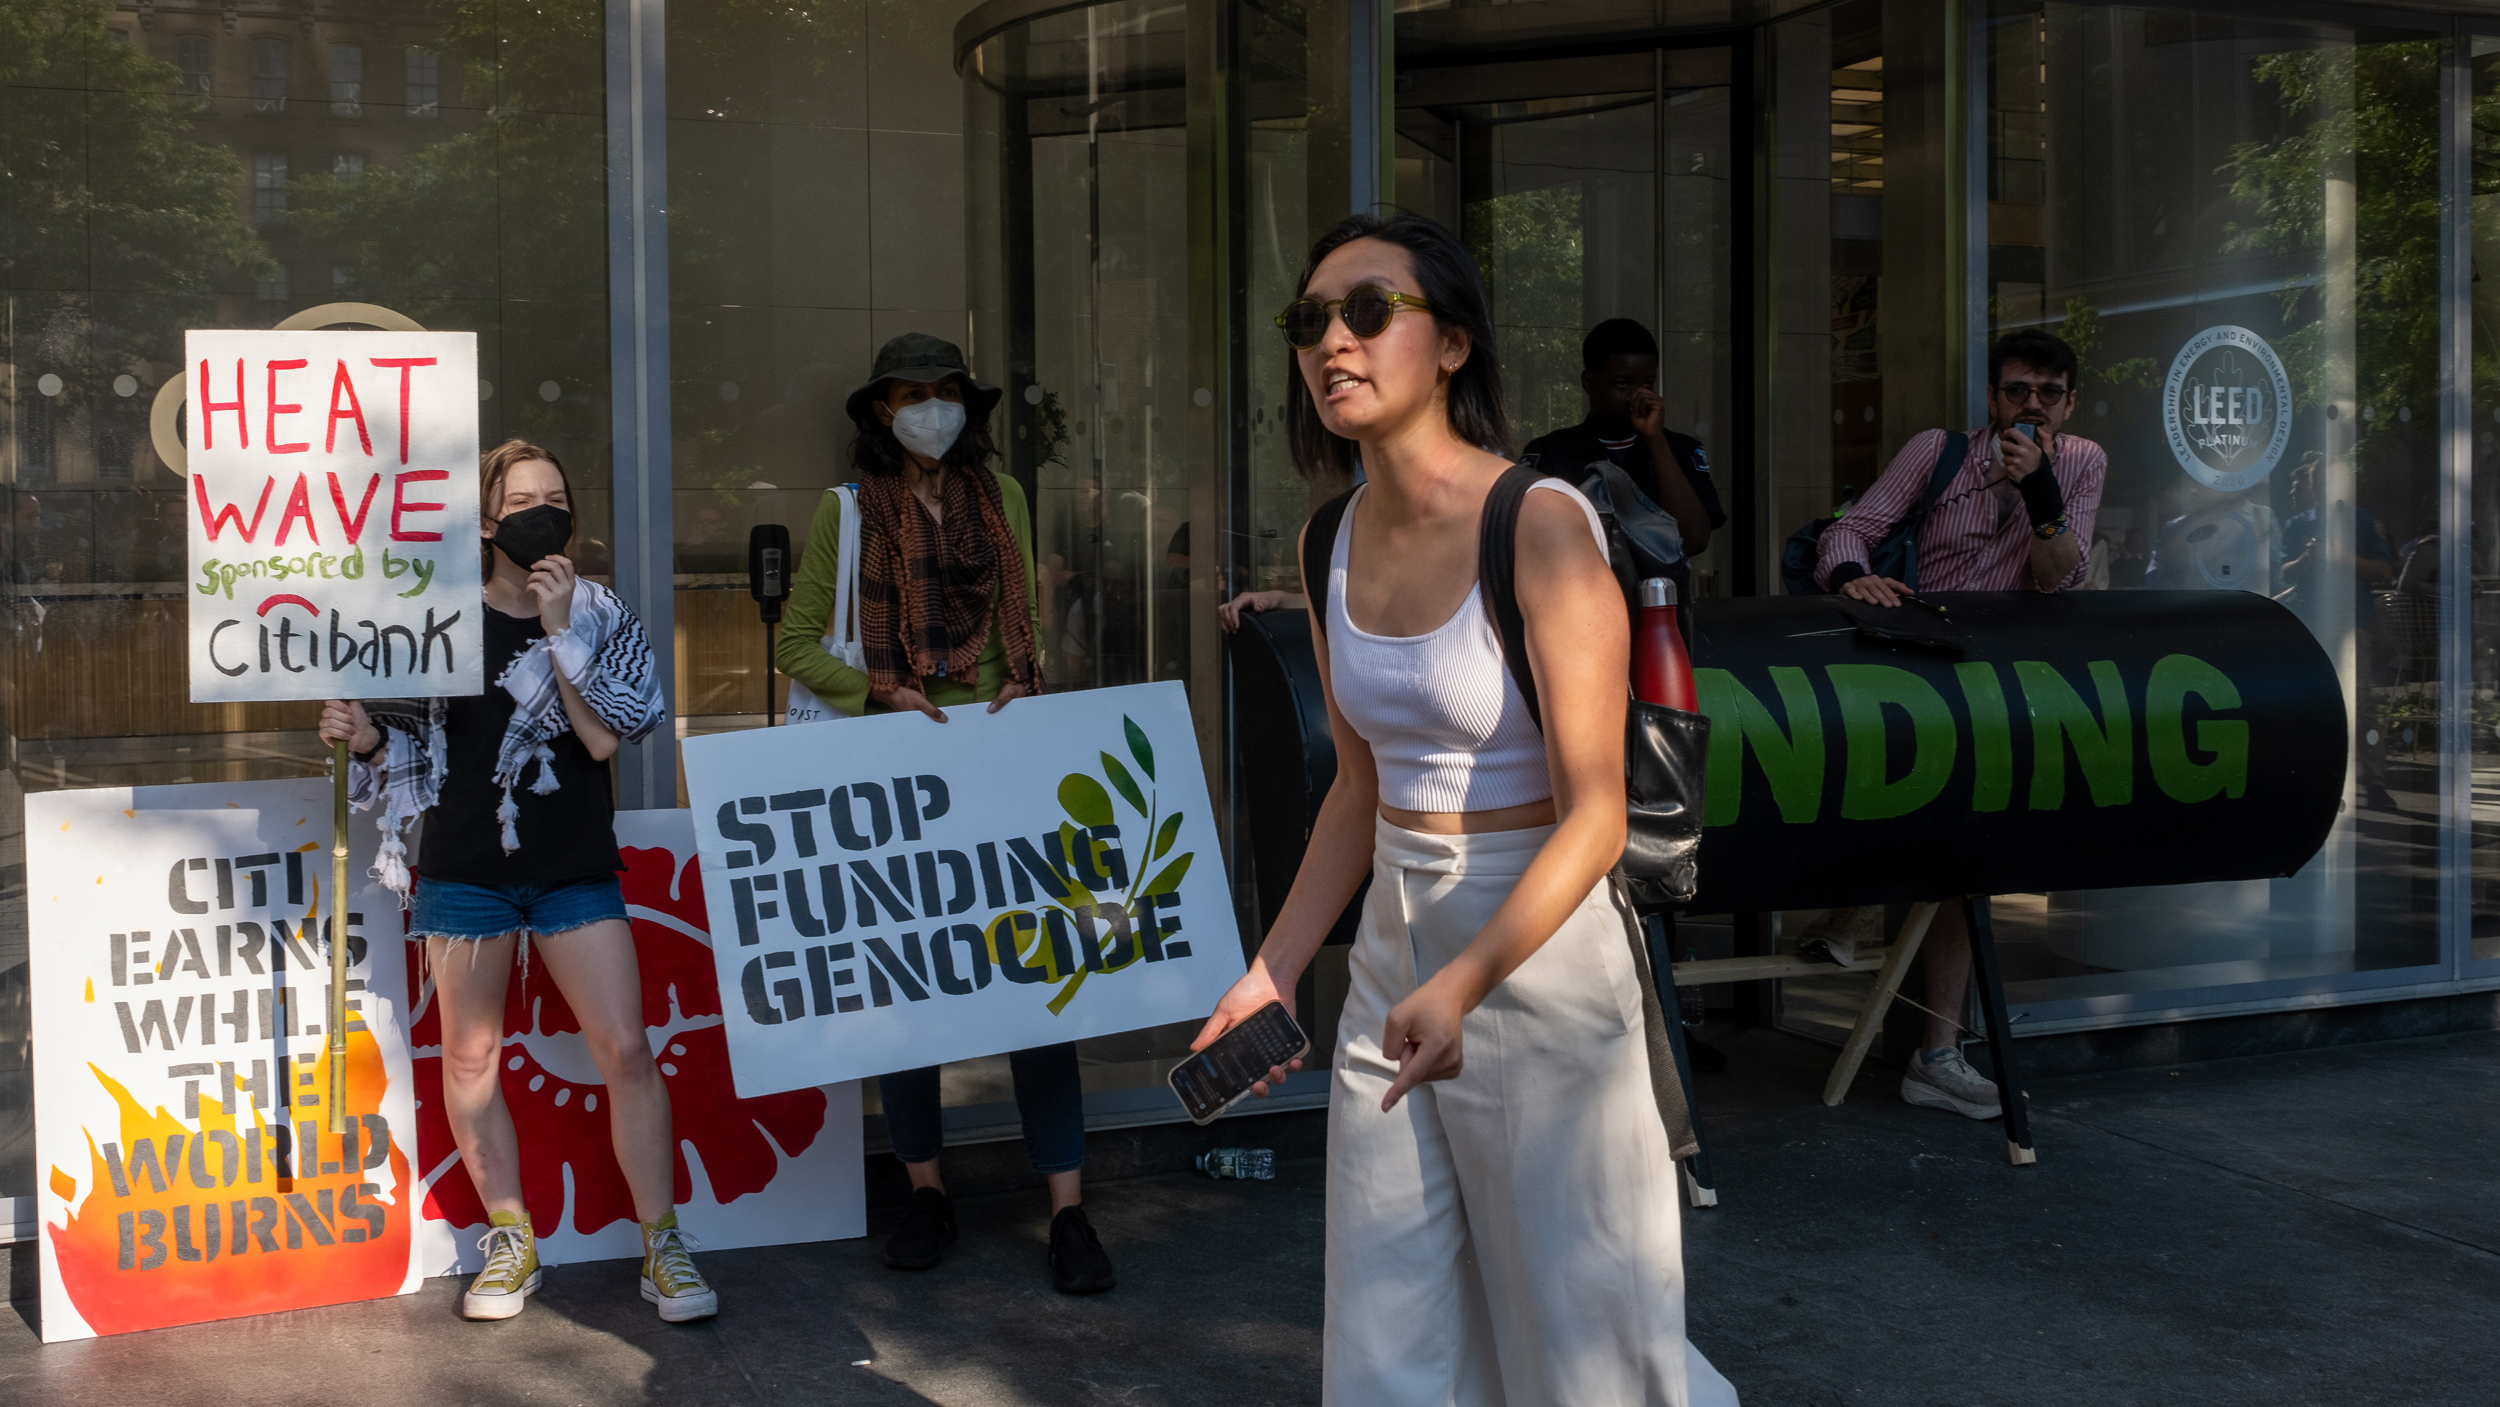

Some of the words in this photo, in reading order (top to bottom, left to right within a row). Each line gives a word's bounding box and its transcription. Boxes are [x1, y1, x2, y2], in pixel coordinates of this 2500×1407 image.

[2179, 334, 2213, 369] ENERGY
[2216, 331, 2237, 341] AND
[2172, 369, 2183, 383] IN
[2193, 386, 2263, 425] LEED
[2239, 333, 2289, 417] ENVIRONMENTAL
[200, 357, 438, 465] HEAT
[2167, 386, 2191, 462] LEADERSHIP
[2198, 434, 2259, 449] PLATINUM
[2265, 421, 2288, 463] DESIGN
[192, 469, 450, 547] WAVE
[2213, 475, 2245, 487] 2020
[195, 544, 364, 600] sponsored
[382, 547, 434, 599] by
[716, 774, 951, 869] STOP
[168, 852, 305, 915] CITI
[729, 824, 1130, 947] FUNDING
[109, 912, 369, 987] EARNS
[740, 891, 1193, 1026] GENOCIDE
[167, 1052, 320, 1120] THE
[102, 1113, 390, 1198] WORLD
[116, 1182, 387, 1272] BURNS
